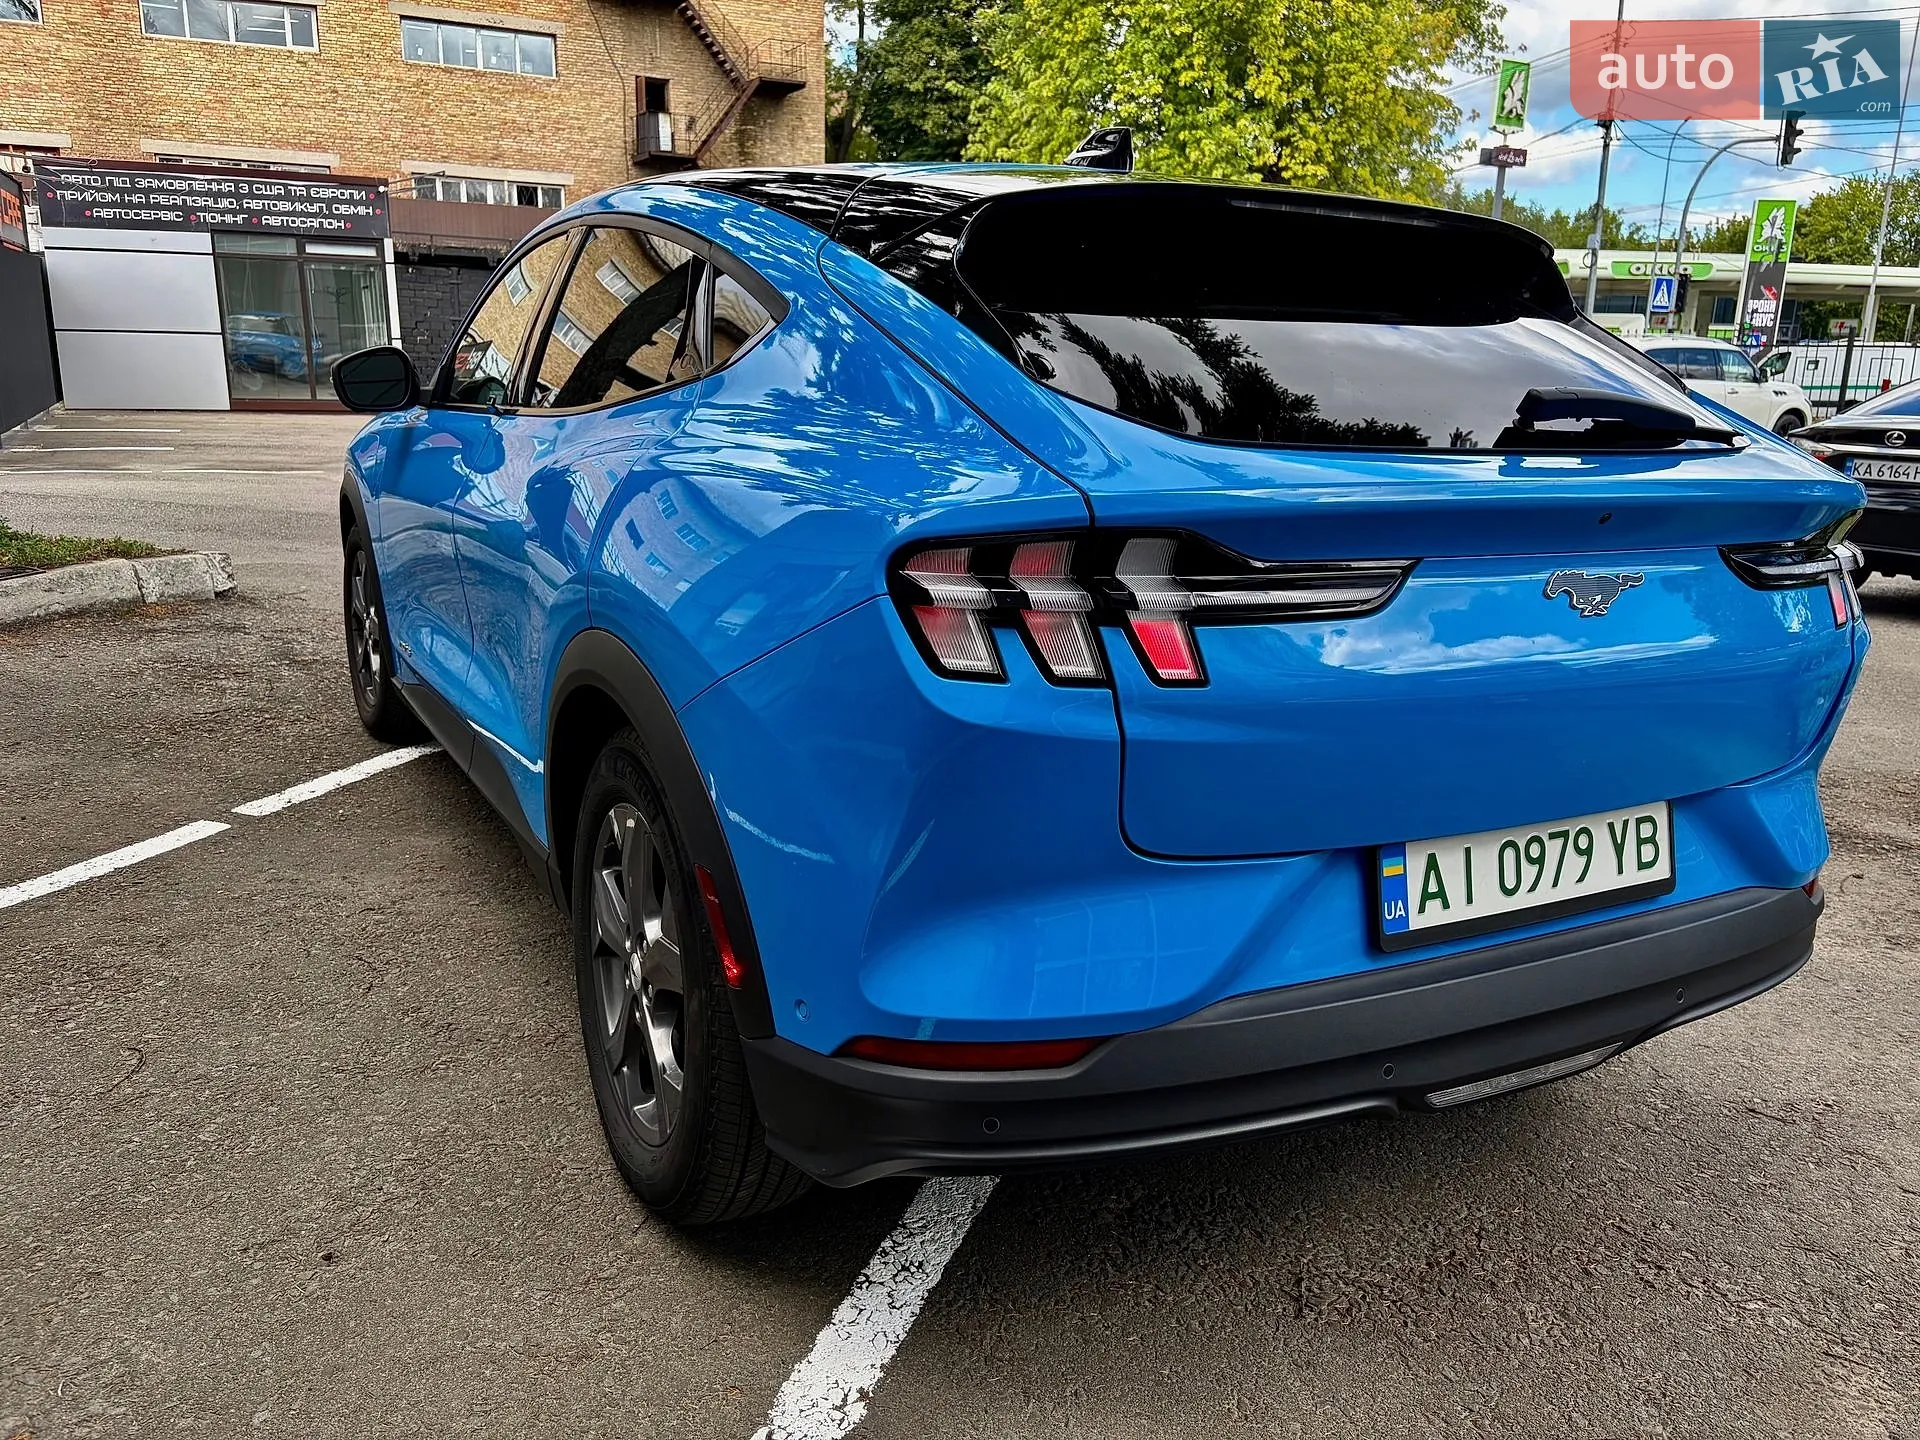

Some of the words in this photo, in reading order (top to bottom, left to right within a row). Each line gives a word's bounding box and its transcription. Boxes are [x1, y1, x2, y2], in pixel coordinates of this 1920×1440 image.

[61, 174, 101, 186] АВТО
[106, 176, 131, 188] ПІД
[135, 178, 235, 193] ЗАМОВЛЕННЯ
[253, 184, 285, 196] США
[288, 186, 307, 197] ТА
[310, 187, 366, 201] ЄВРОПИ
[57, 190, 120, 204] ПРИЙОМ
[125, 193, 146, 204] НА
[150, 194, 240, 210] РЕАЛІЗАЦІЮ,
[243, 200, 329, 215] АВТОВИКУП,
[332, 204, 373, 217] ОБМІН
[93, 208, 184, 222] АВТОСЕРВІС
[262, 215, 345, 230] АВТОСАЛОН
[1852, 462, 1872, 477] KA
[1877, 463, 1911, 480] 6164
[1497, 824, 1595, 897] 0979
[1607, 814, 1661, 875] YB
[1384, 900, 1406, 921] UA
